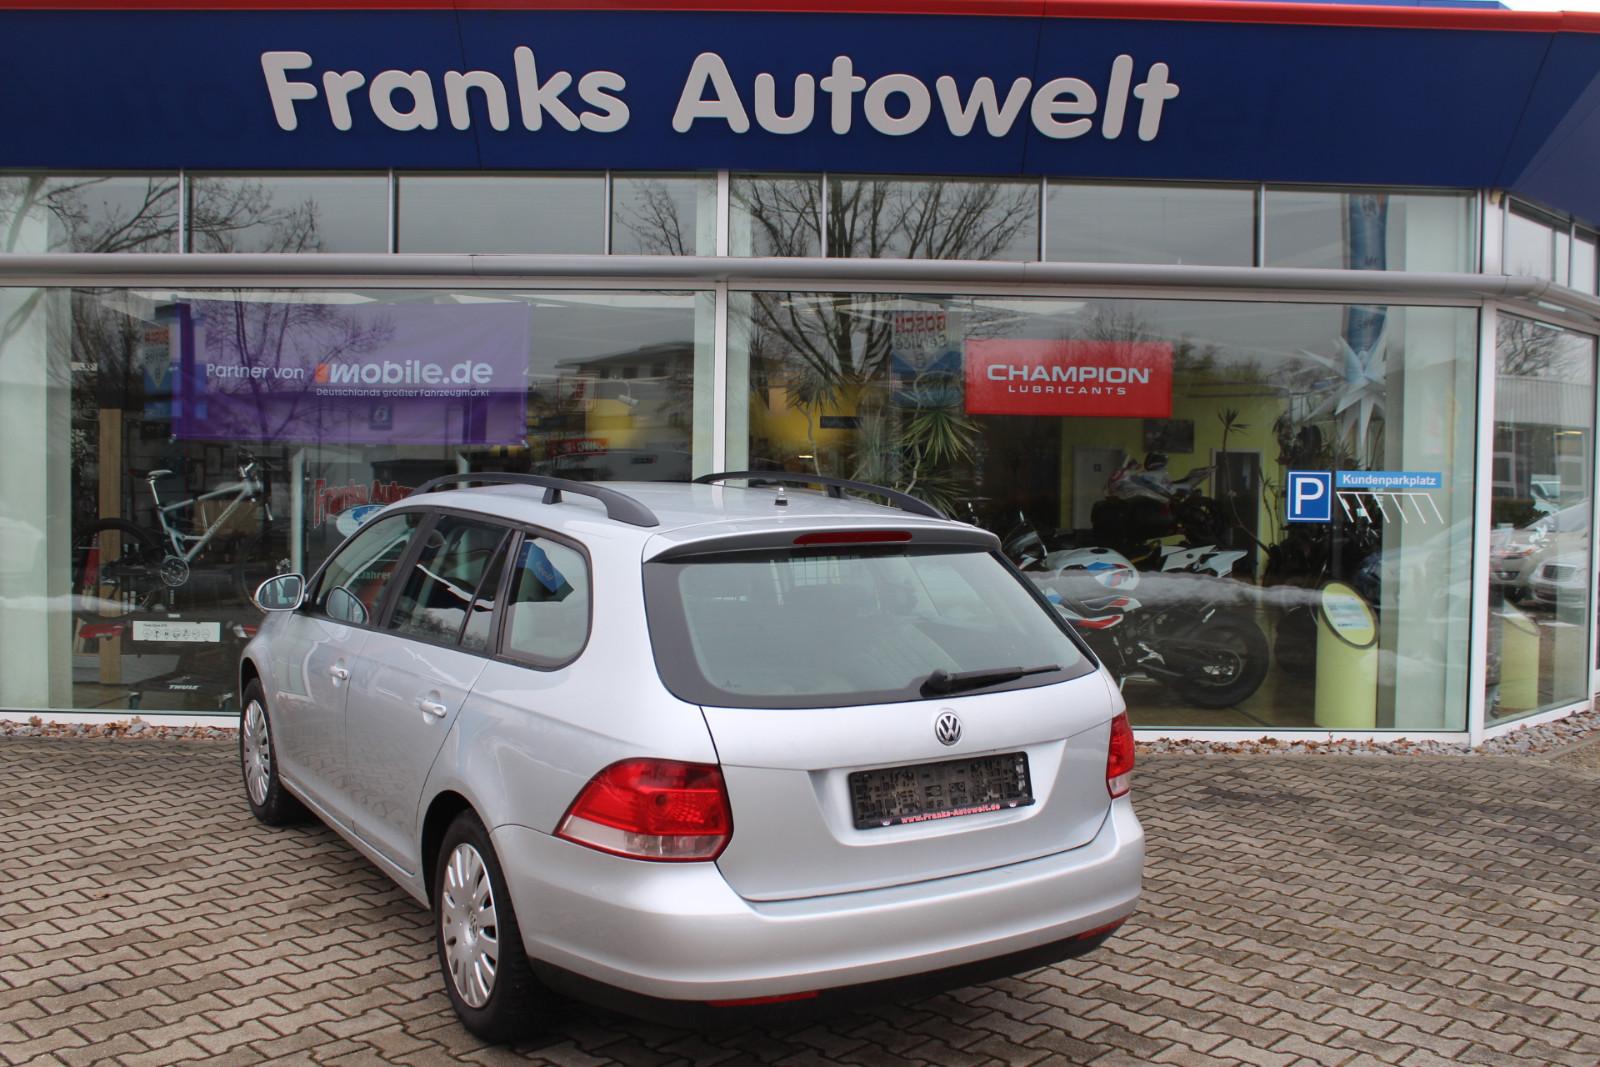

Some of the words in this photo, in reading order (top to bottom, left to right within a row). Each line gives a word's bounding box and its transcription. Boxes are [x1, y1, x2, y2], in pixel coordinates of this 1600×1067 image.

[261, 46, 630, 133] Franks
[672, 52, 1179, 142] Autowelt
[206, 364, 269, 379] Partner
[273, 366, 304, 379] von
[330, 360, 493, 384] mobile.de
[987, 364, 1150, 384] CHAMPION
[316, 387, 380, 397] Deutschlands
[1008, 385, 1126, 395] LUBRICANTS
[1343, 474, 1436, 486] Kundenparkplatz
